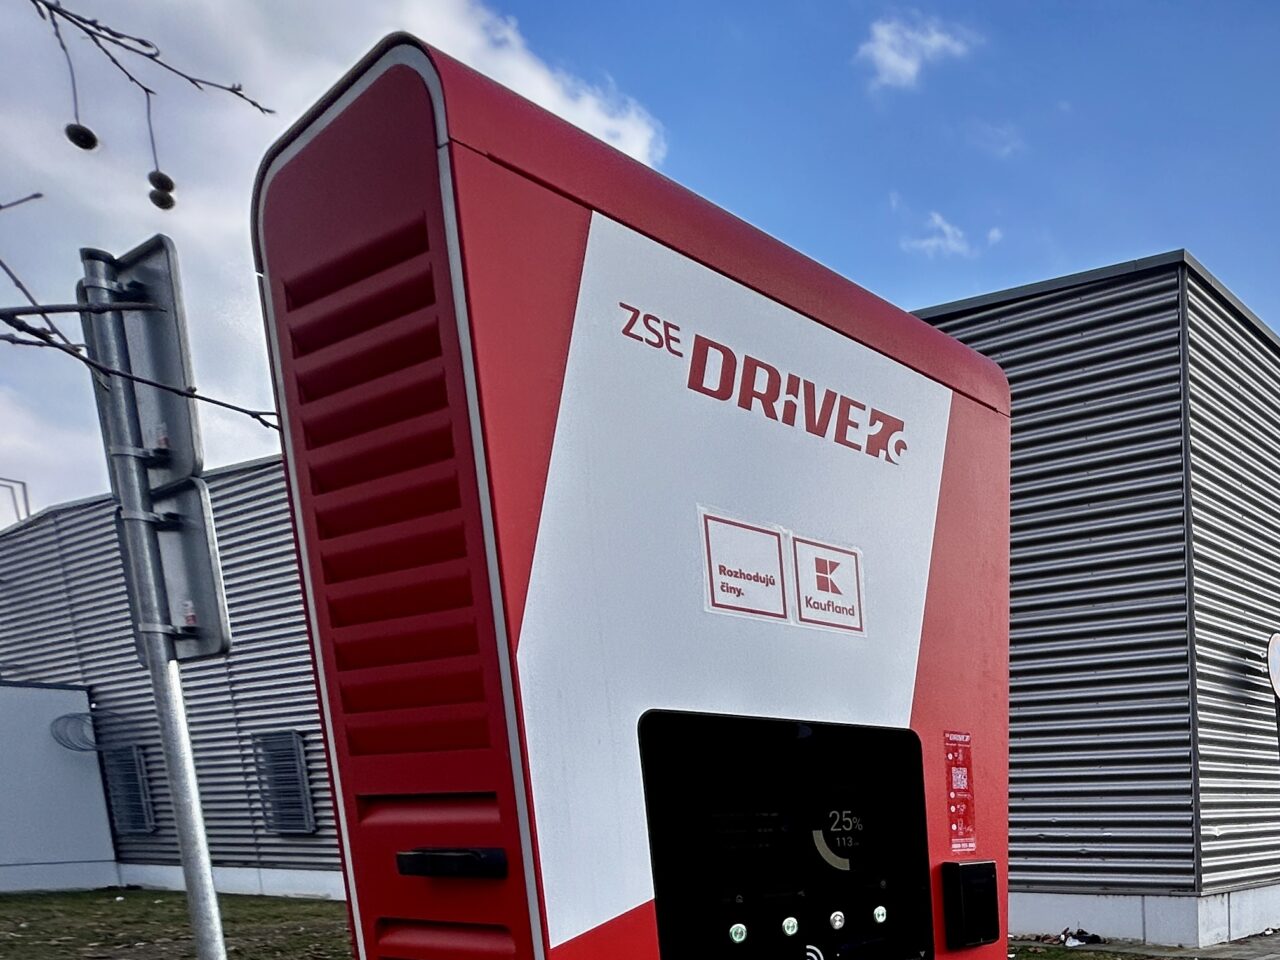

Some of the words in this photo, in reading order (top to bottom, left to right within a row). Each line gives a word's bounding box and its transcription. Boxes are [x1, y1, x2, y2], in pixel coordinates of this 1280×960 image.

[619, 302, 684, 358] ZSE
[718, 564, 775, 587] Rozhodujú
[720, 582, 745, 597] činy.
[805, 596, 855, 617] Kaufland
[829, 810, 863, 831] 25%
[836, 836, 853, 847] 113
